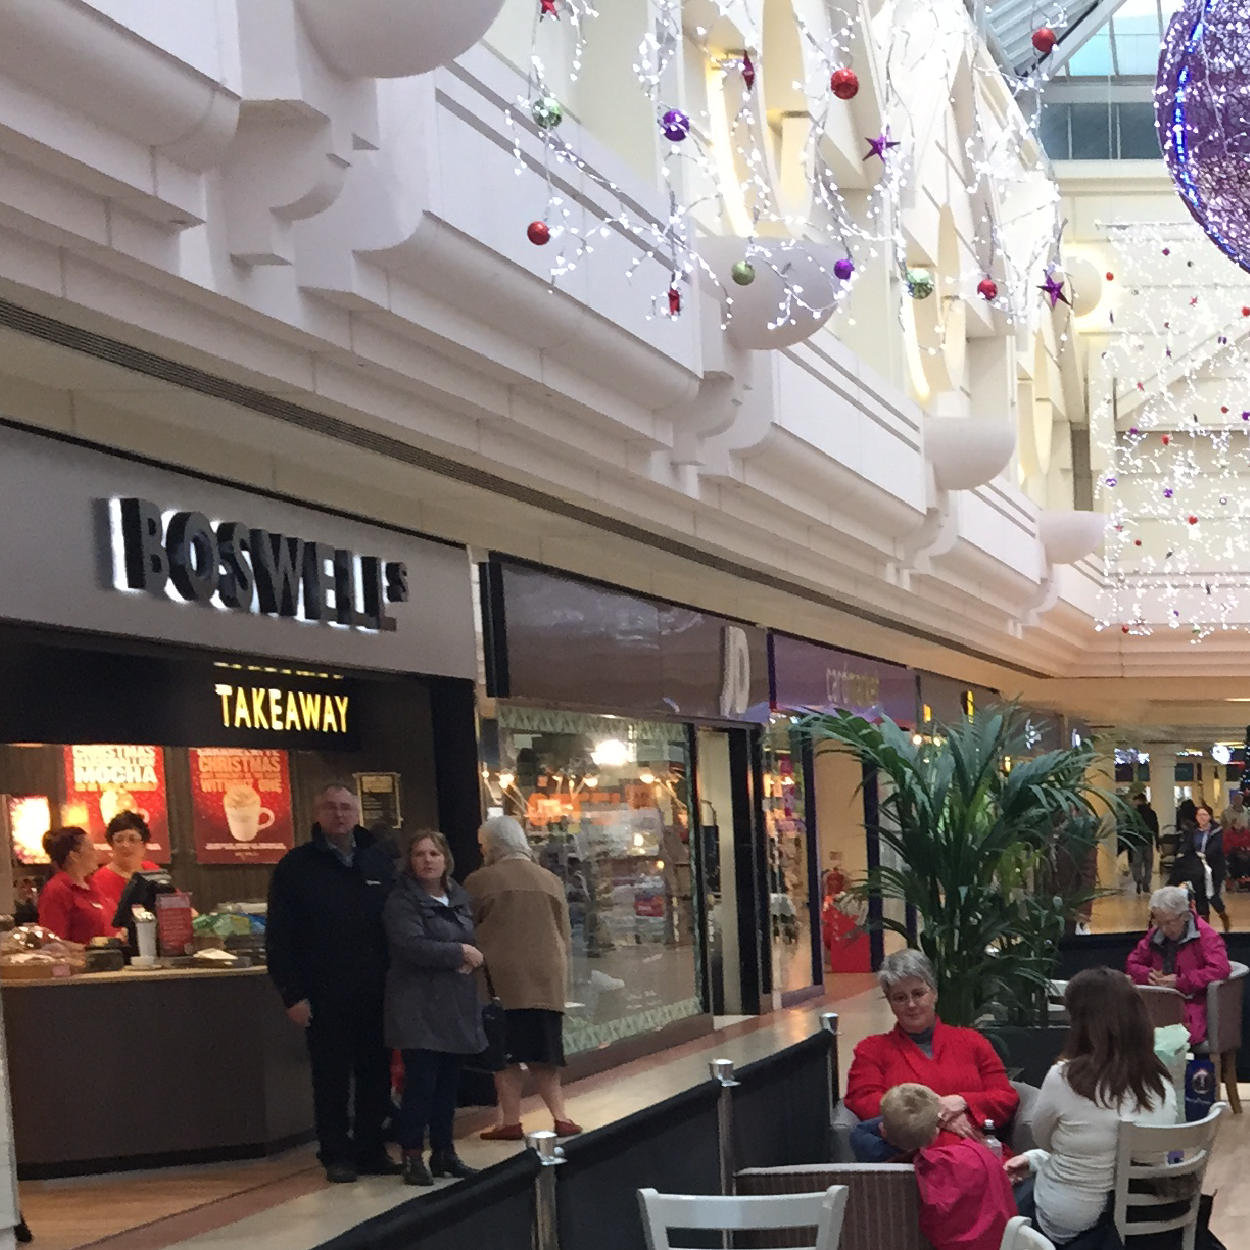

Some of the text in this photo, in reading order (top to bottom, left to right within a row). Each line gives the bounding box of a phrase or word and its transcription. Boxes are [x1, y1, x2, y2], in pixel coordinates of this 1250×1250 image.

[214, 683, 349, 733] TAKEAWAY
[199, 756, 281, 772] CHRISTMAS
[75, 765, 158, 784] MOCHA
